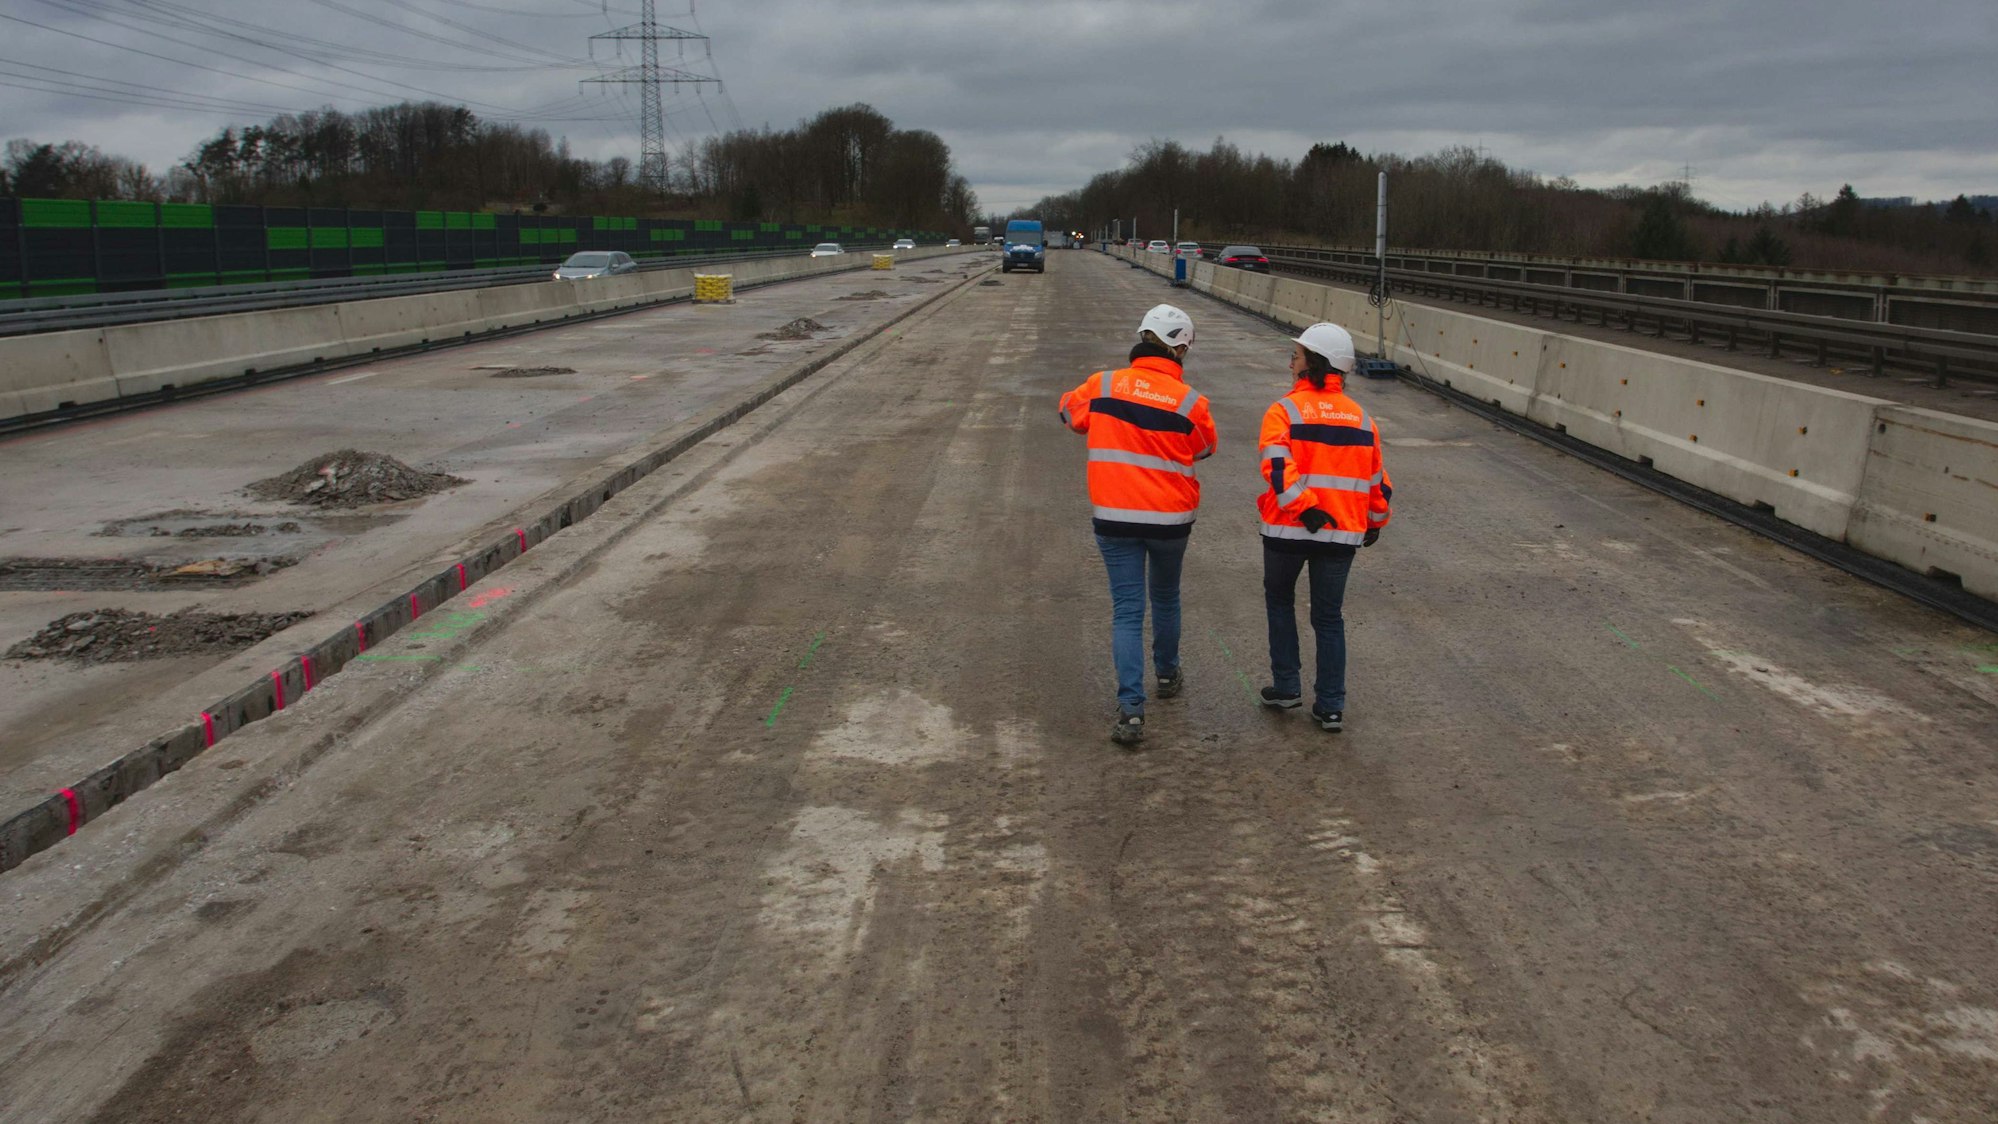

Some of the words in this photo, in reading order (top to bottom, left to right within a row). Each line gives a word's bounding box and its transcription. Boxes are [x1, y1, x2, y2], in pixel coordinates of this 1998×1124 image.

[1135, 379, 1150, 389] Die
[1133, 388, 1177, 405] Autobahn
[1319, 401, 1333, 410] Die
[1320, 411, 1360, 422] Autobahn
